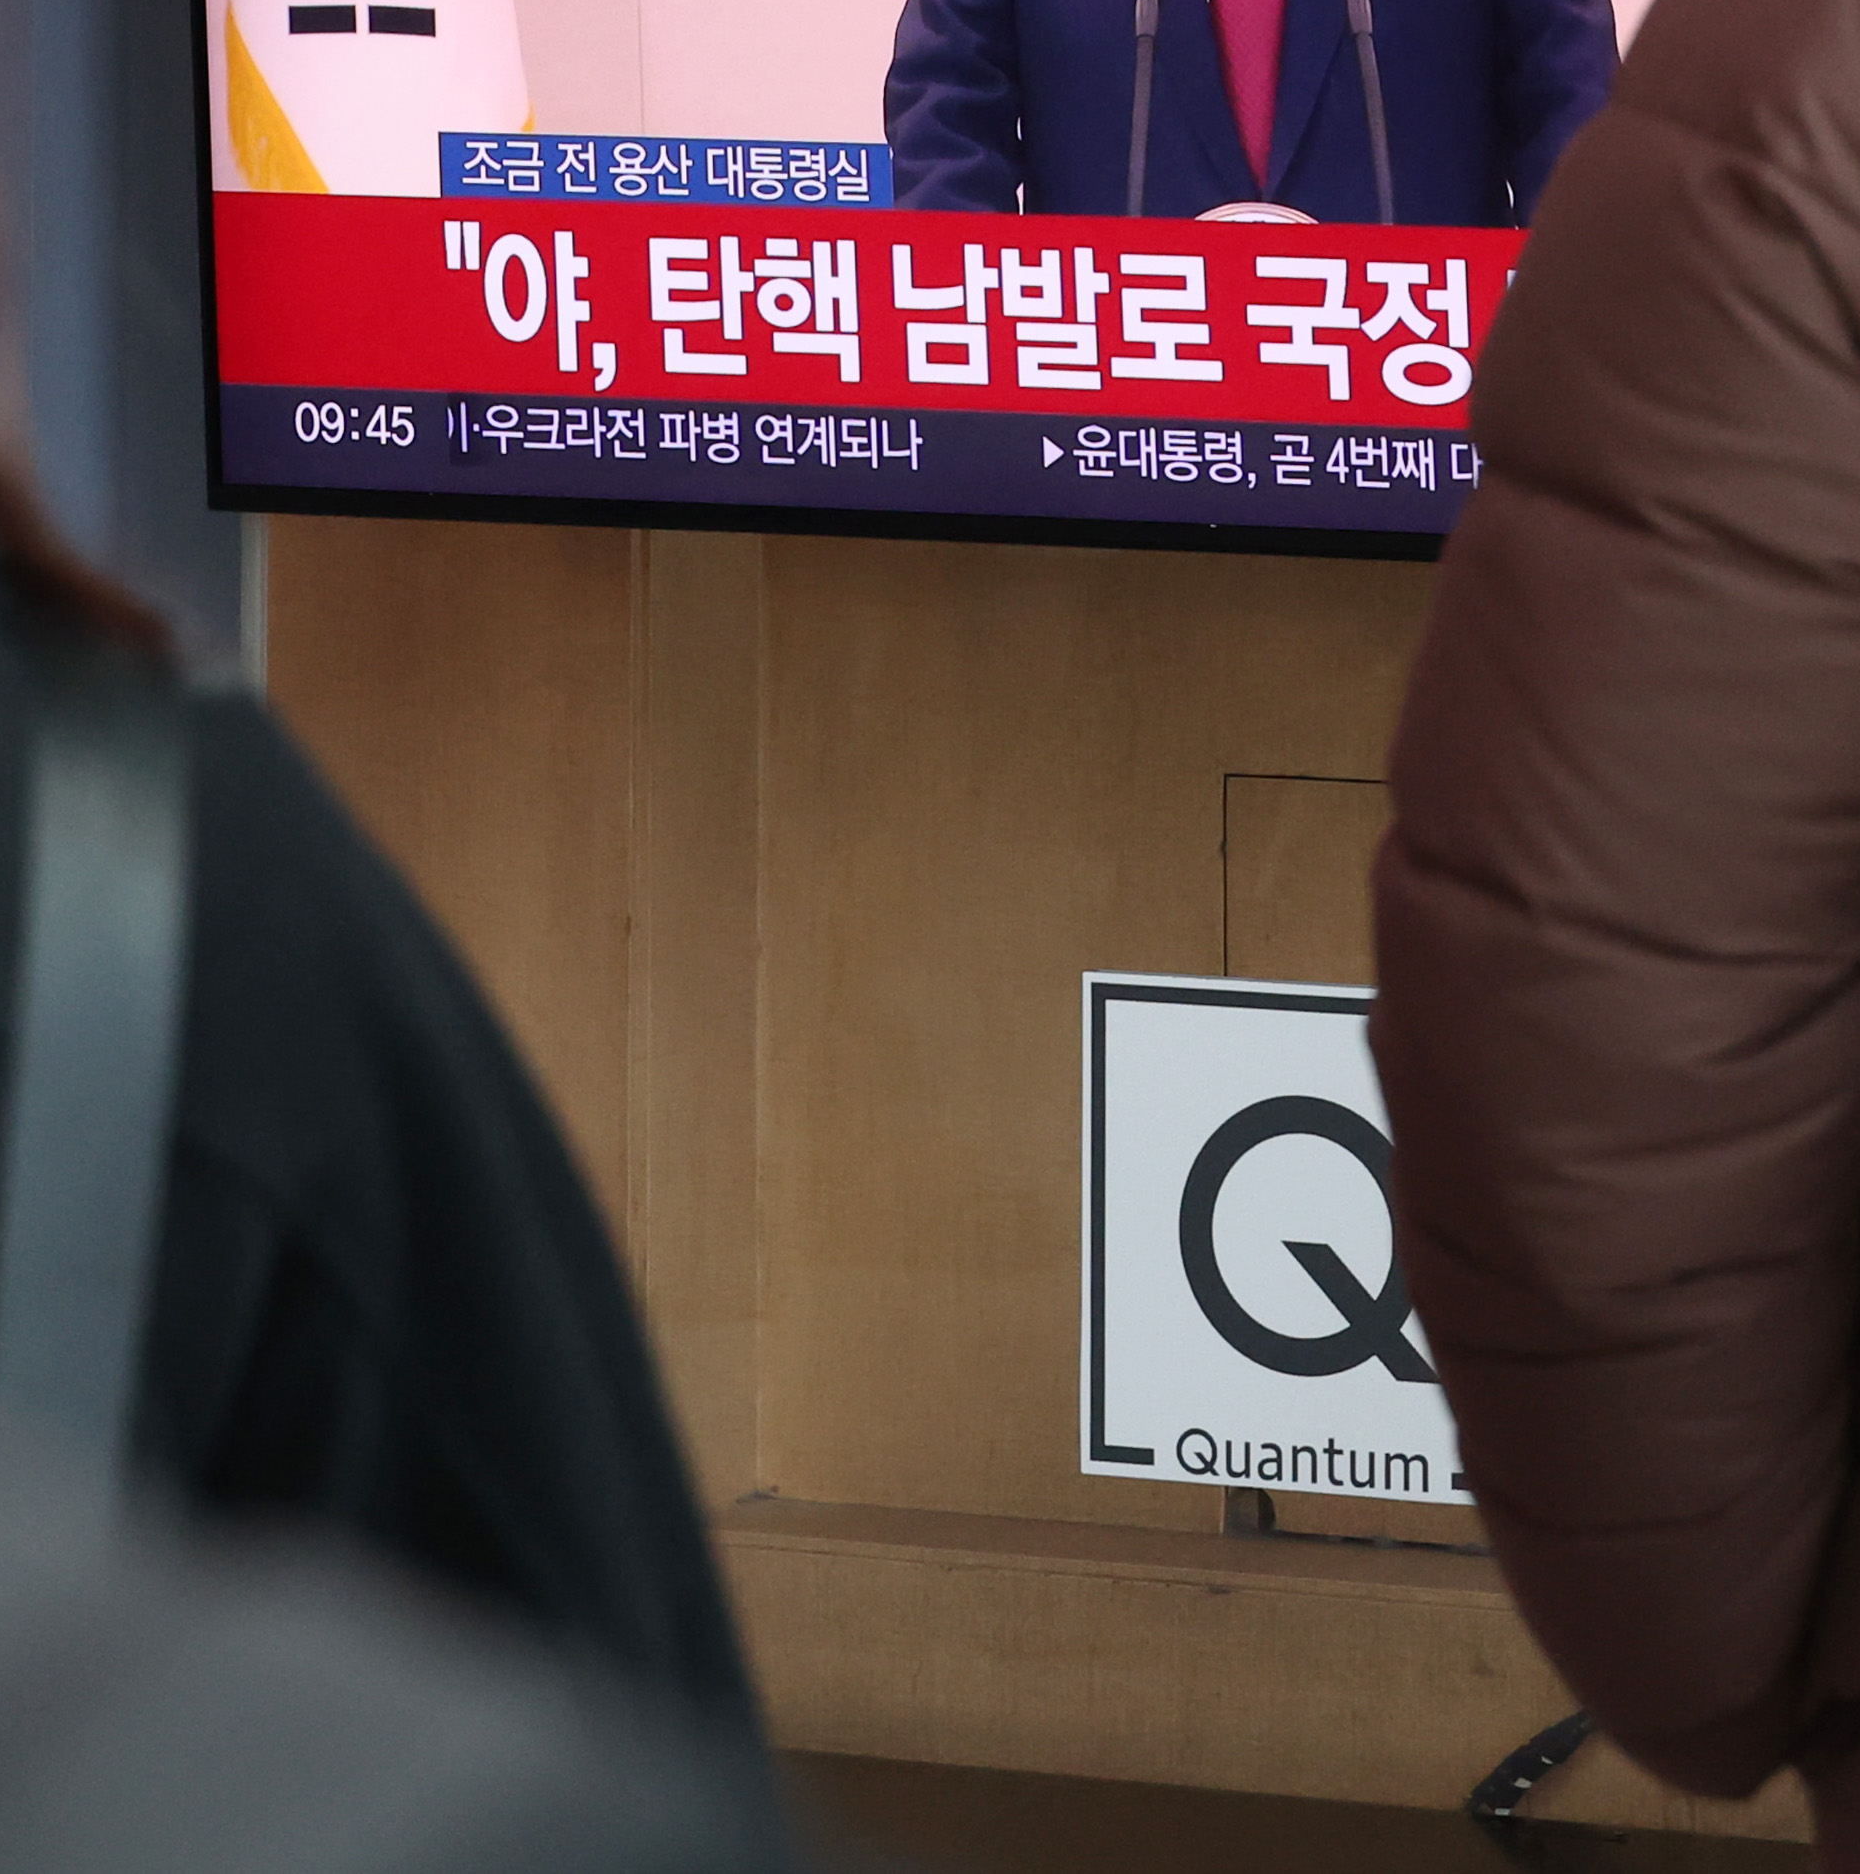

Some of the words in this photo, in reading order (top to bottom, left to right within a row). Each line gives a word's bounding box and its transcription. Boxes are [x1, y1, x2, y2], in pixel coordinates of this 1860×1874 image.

[461, 141, 545, 193] 조금
[556, 143, 597, 194] 전
[608, 143, 692, 196] 용산
[706, 145, 870, 202] 대통령실
[648, 235, 861, 383] 탄핵
[891, 242, 1223, 391] 남발로
[1246, 255, 1473, 406] 국정
[294, 401, 415, 446] 09:45
[658, 410, 740, 465] 파병
[754, 413, 923, 472] 연계되나
[1072, 424, 1257, 490] 윤대통령,
[1269, 433, 1315, 486] 곧
[1325, 436, 1436, 492] 4번째
[1179, 1095, 1440, 1384] Q
[1176, 1427, 1429, 1493] Quantum
